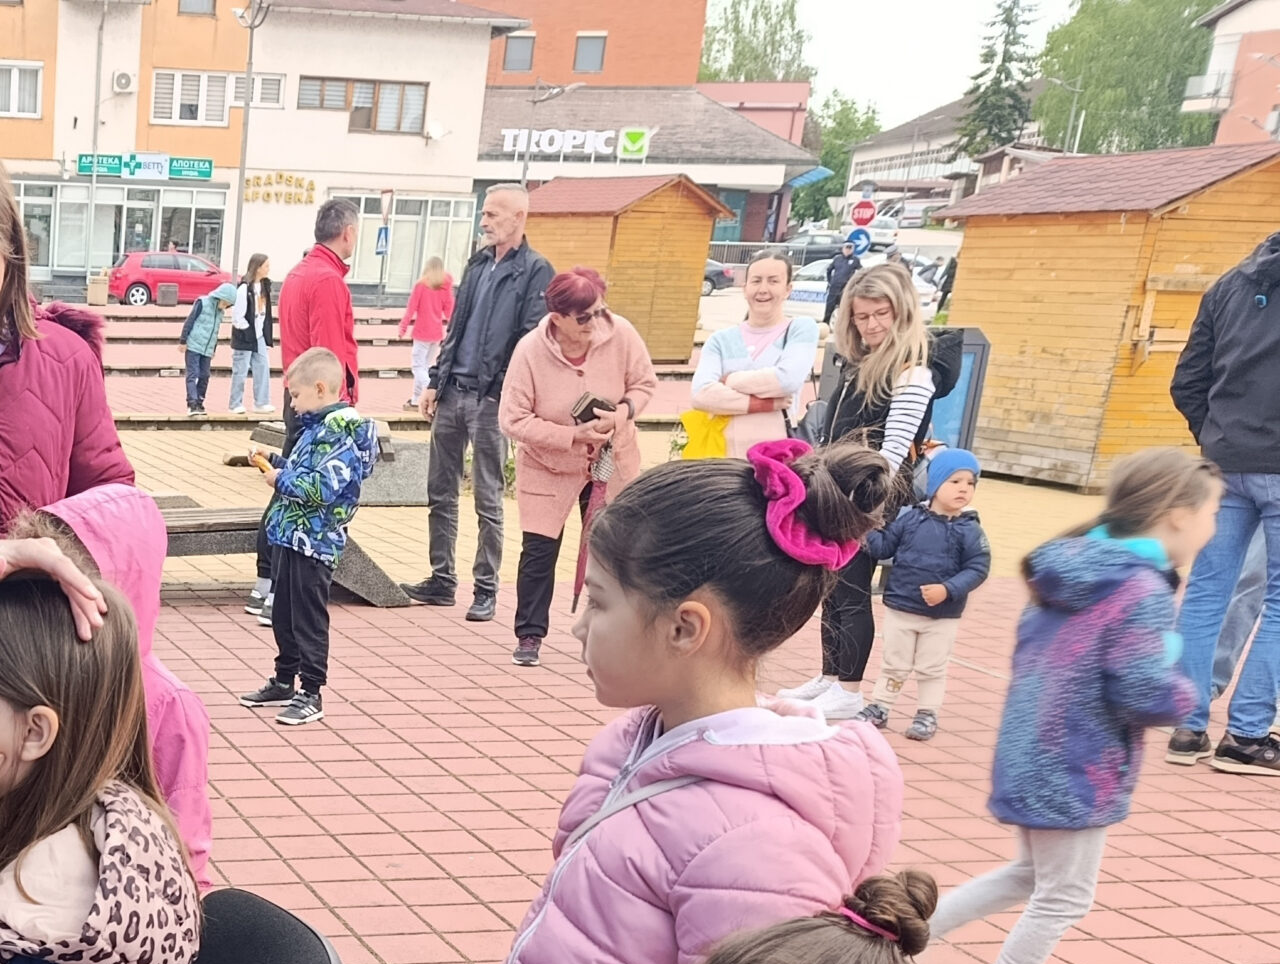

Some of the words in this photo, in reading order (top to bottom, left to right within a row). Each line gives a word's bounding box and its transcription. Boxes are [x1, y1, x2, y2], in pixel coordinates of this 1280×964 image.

[501, 128, 616, 154] TROPIC
[172, 160, 210, 169] АПОТЕКА
[853, 208, 874, 216] STOP
